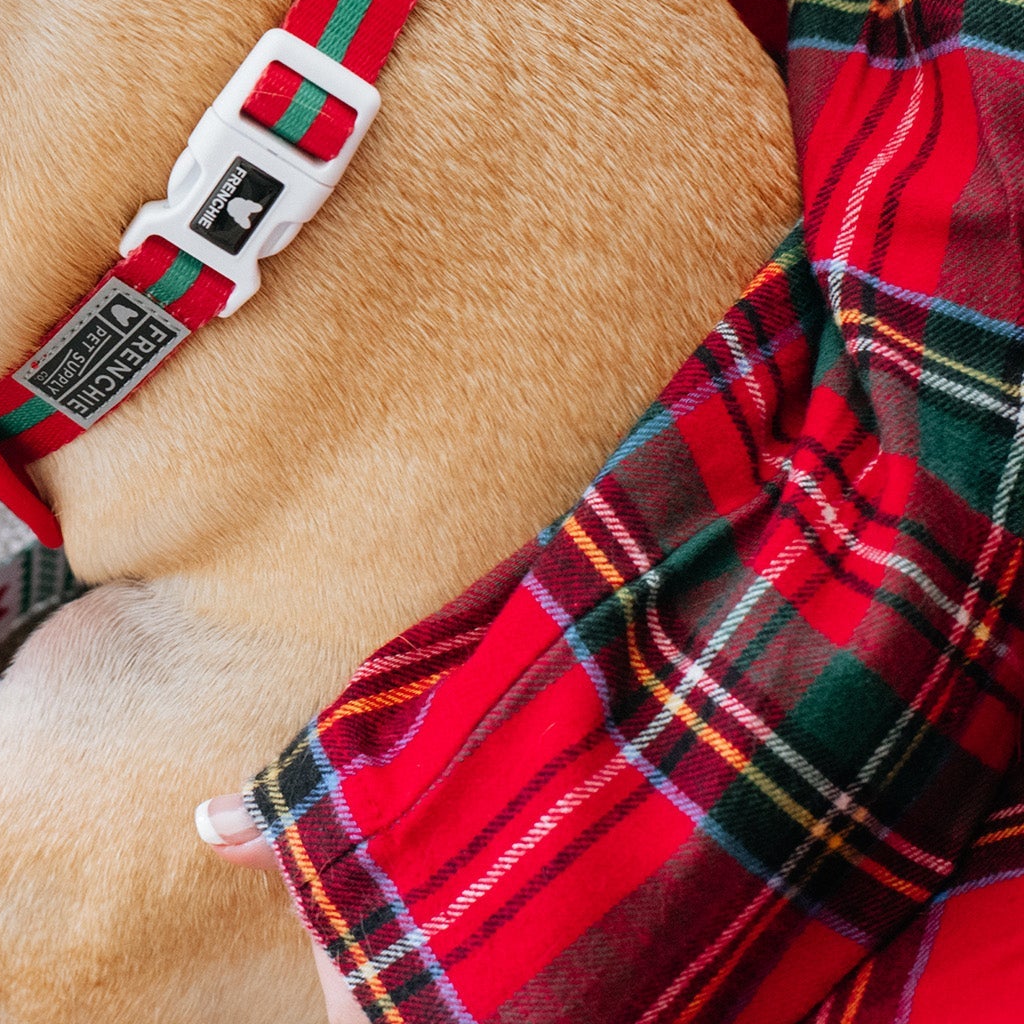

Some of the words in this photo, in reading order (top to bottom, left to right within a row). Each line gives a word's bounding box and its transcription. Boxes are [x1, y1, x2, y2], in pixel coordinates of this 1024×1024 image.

[198, 166, 247, 230] FRENCHIE
[81, 325, 108, 353] PET
[47, 351, 86, 395] SUPPLY
[66, 323, 168, 414] FRENCHIE
